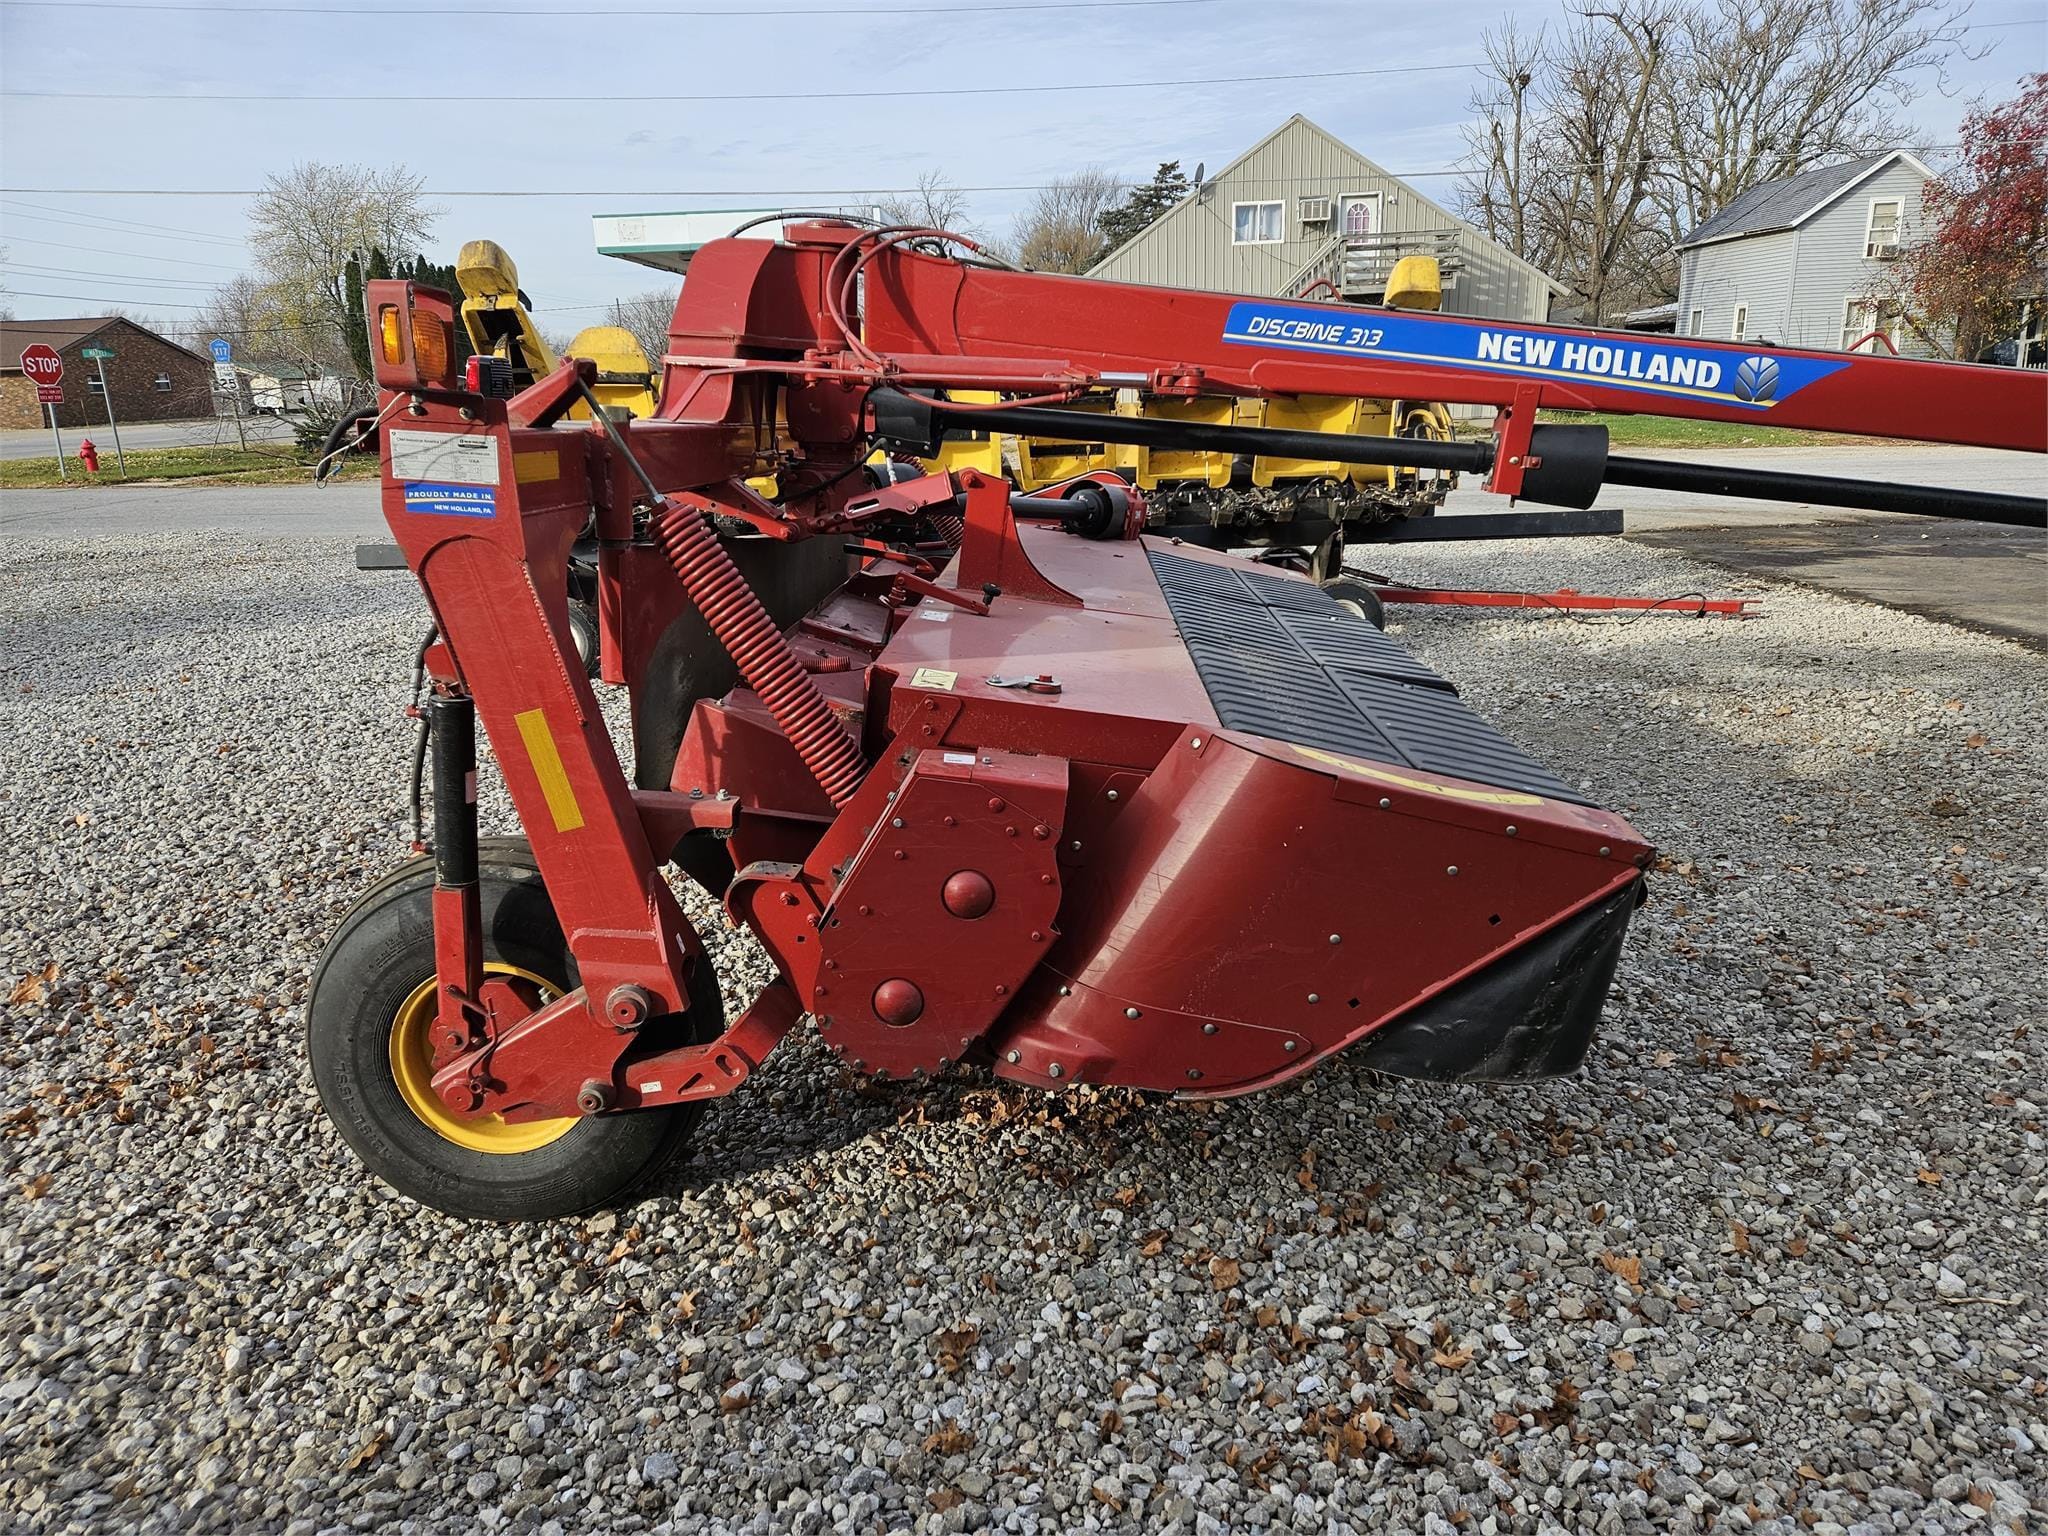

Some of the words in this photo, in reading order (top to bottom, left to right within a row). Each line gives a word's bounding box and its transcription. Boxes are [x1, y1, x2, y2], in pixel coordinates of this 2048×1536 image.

[1247, 316, 1346, 343] DISCBINE
[1345, 327, 1384, 347] 313
[25, 357, 60, 373] STOP
[1476, 331, 1557, 367] NEW
[1561, 342, 1722, 389] HOLLAND
[219, 378, 237, 389] 25
[408, 491, 450, 499] PROUDLY
